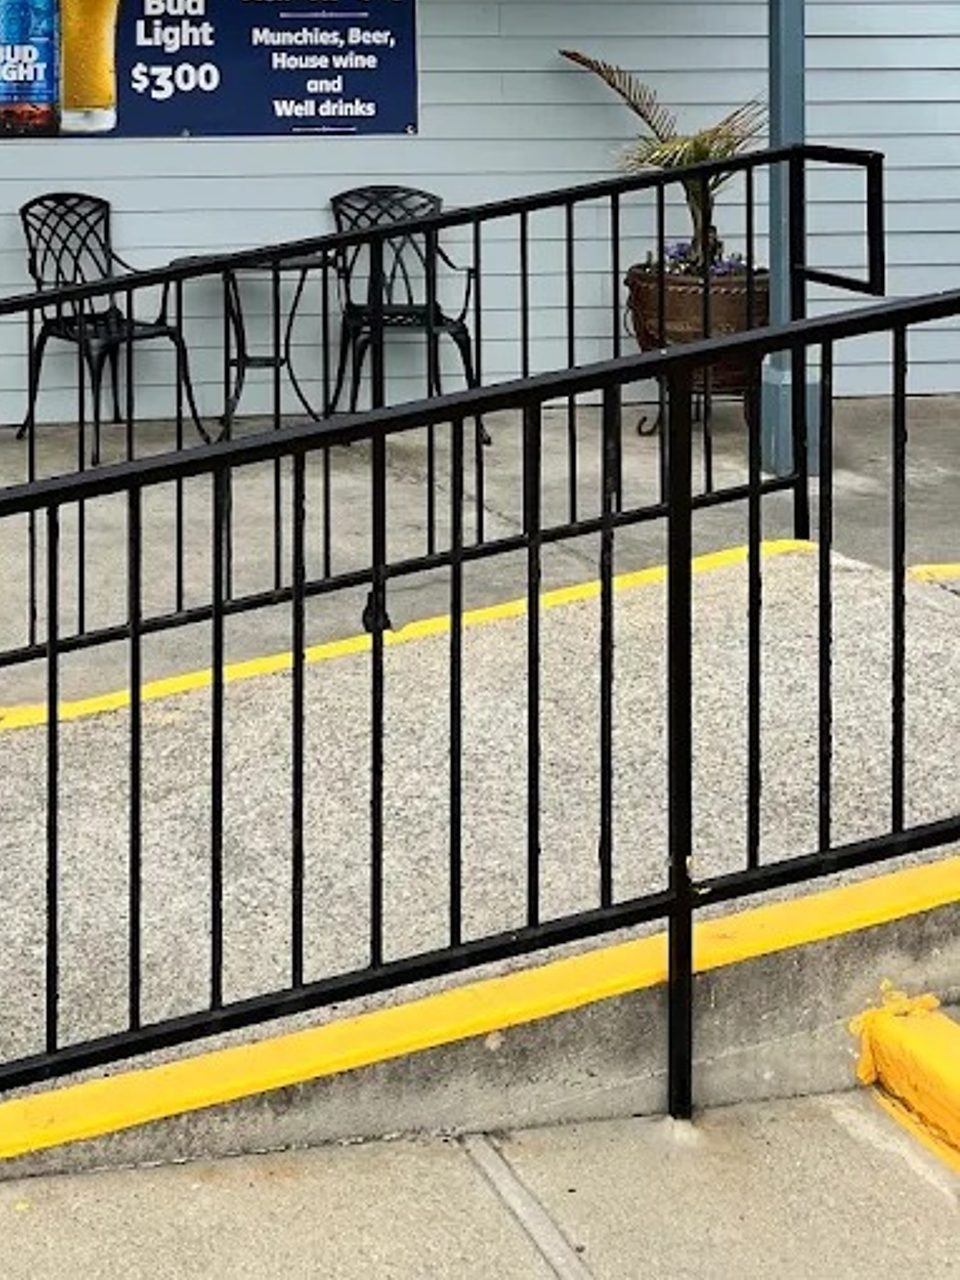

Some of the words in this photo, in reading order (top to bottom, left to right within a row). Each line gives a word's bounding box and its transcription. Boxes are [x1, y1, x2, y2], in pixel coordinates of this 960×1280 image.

[136, 19, 215, 53] Light
[251, 27, 346, 48] Munchies,
[348, 27, 396, 48] Beer,
[271, 52, 330, 69] House
[332, 51, 378, 69] wine
[130, 62, 220, 100] $300
[306, 74, 343, 94] and
[272, 99, 316, 117] Well
[318, 98, 376, 117] drinks
